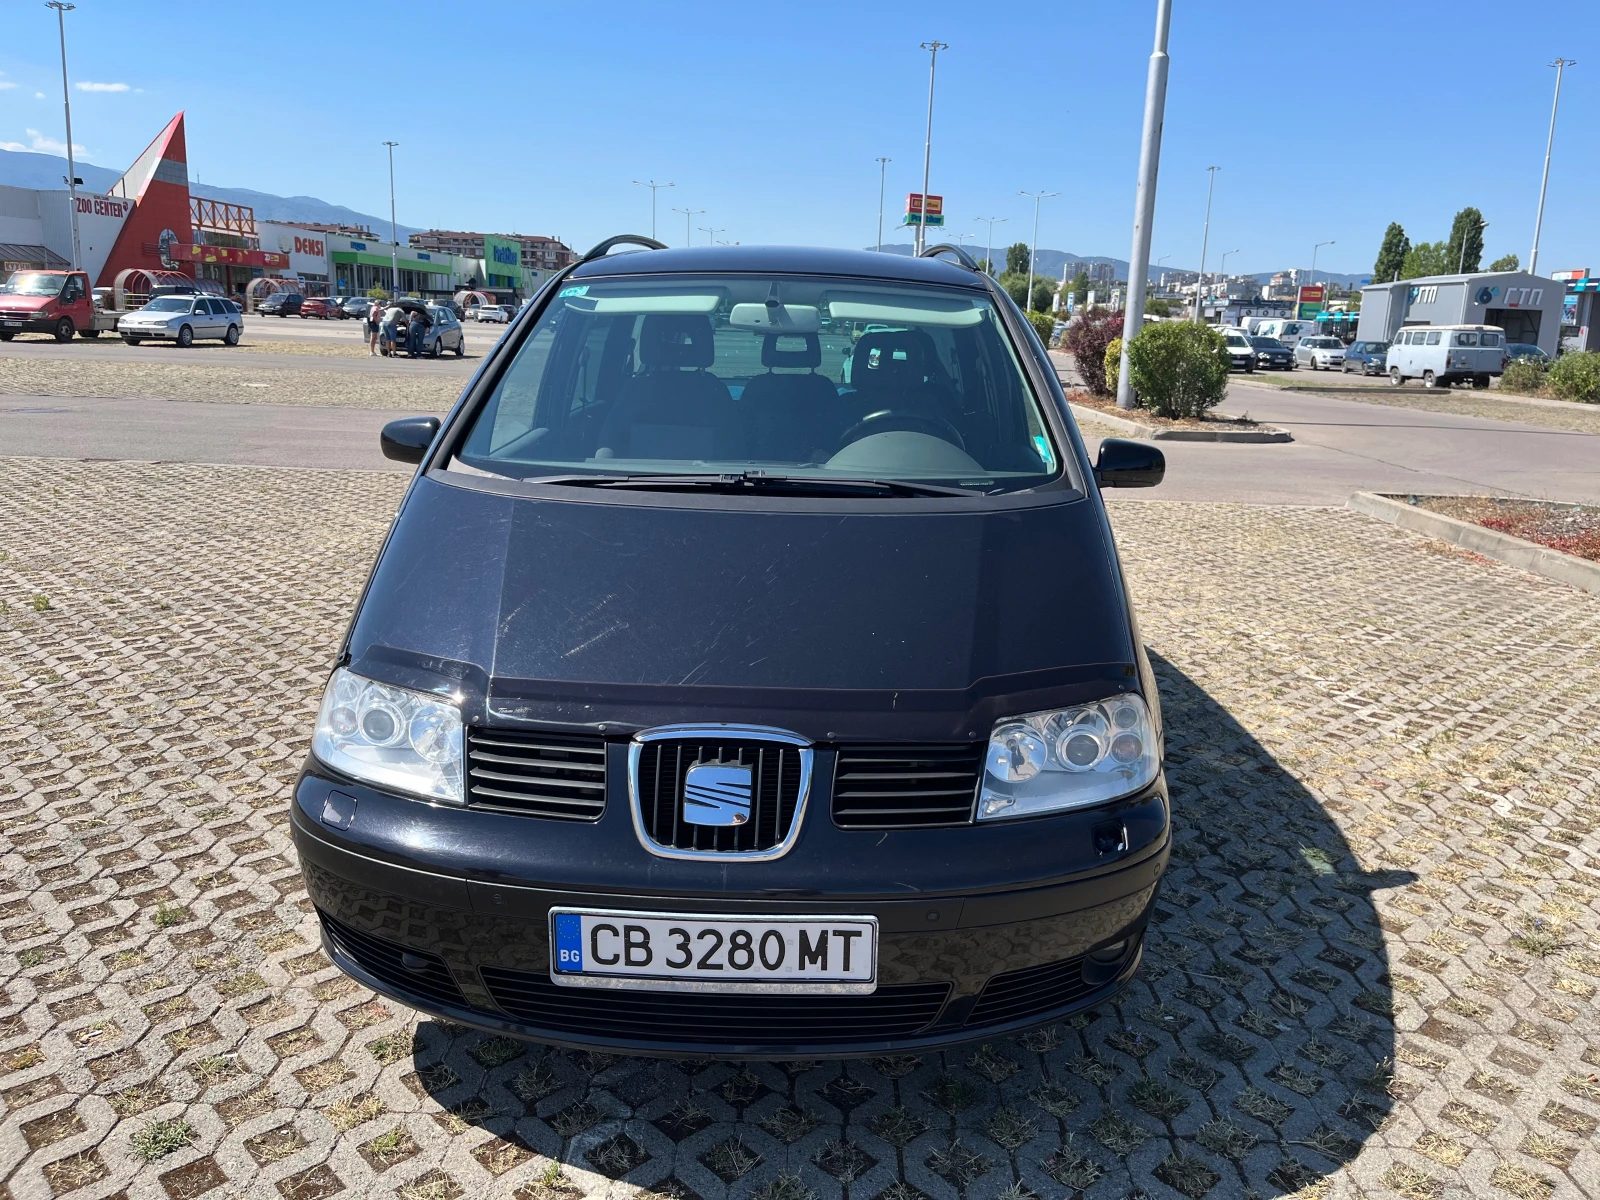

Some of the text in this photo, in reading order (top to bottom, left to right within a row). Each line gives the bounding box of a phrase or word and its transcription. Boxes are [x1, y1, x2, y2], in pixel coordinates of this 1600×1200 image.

[76, 198, 124, 218] ZOO CENTER
[294, 236, 324, 257] DENSI
[1417, 286, 1438, 303] ГТП
[1503, 287, 1544, 305] ГТП
[560, 950, 580, 962] BG
[590, 923, 862, 971] CB 3280 MT
